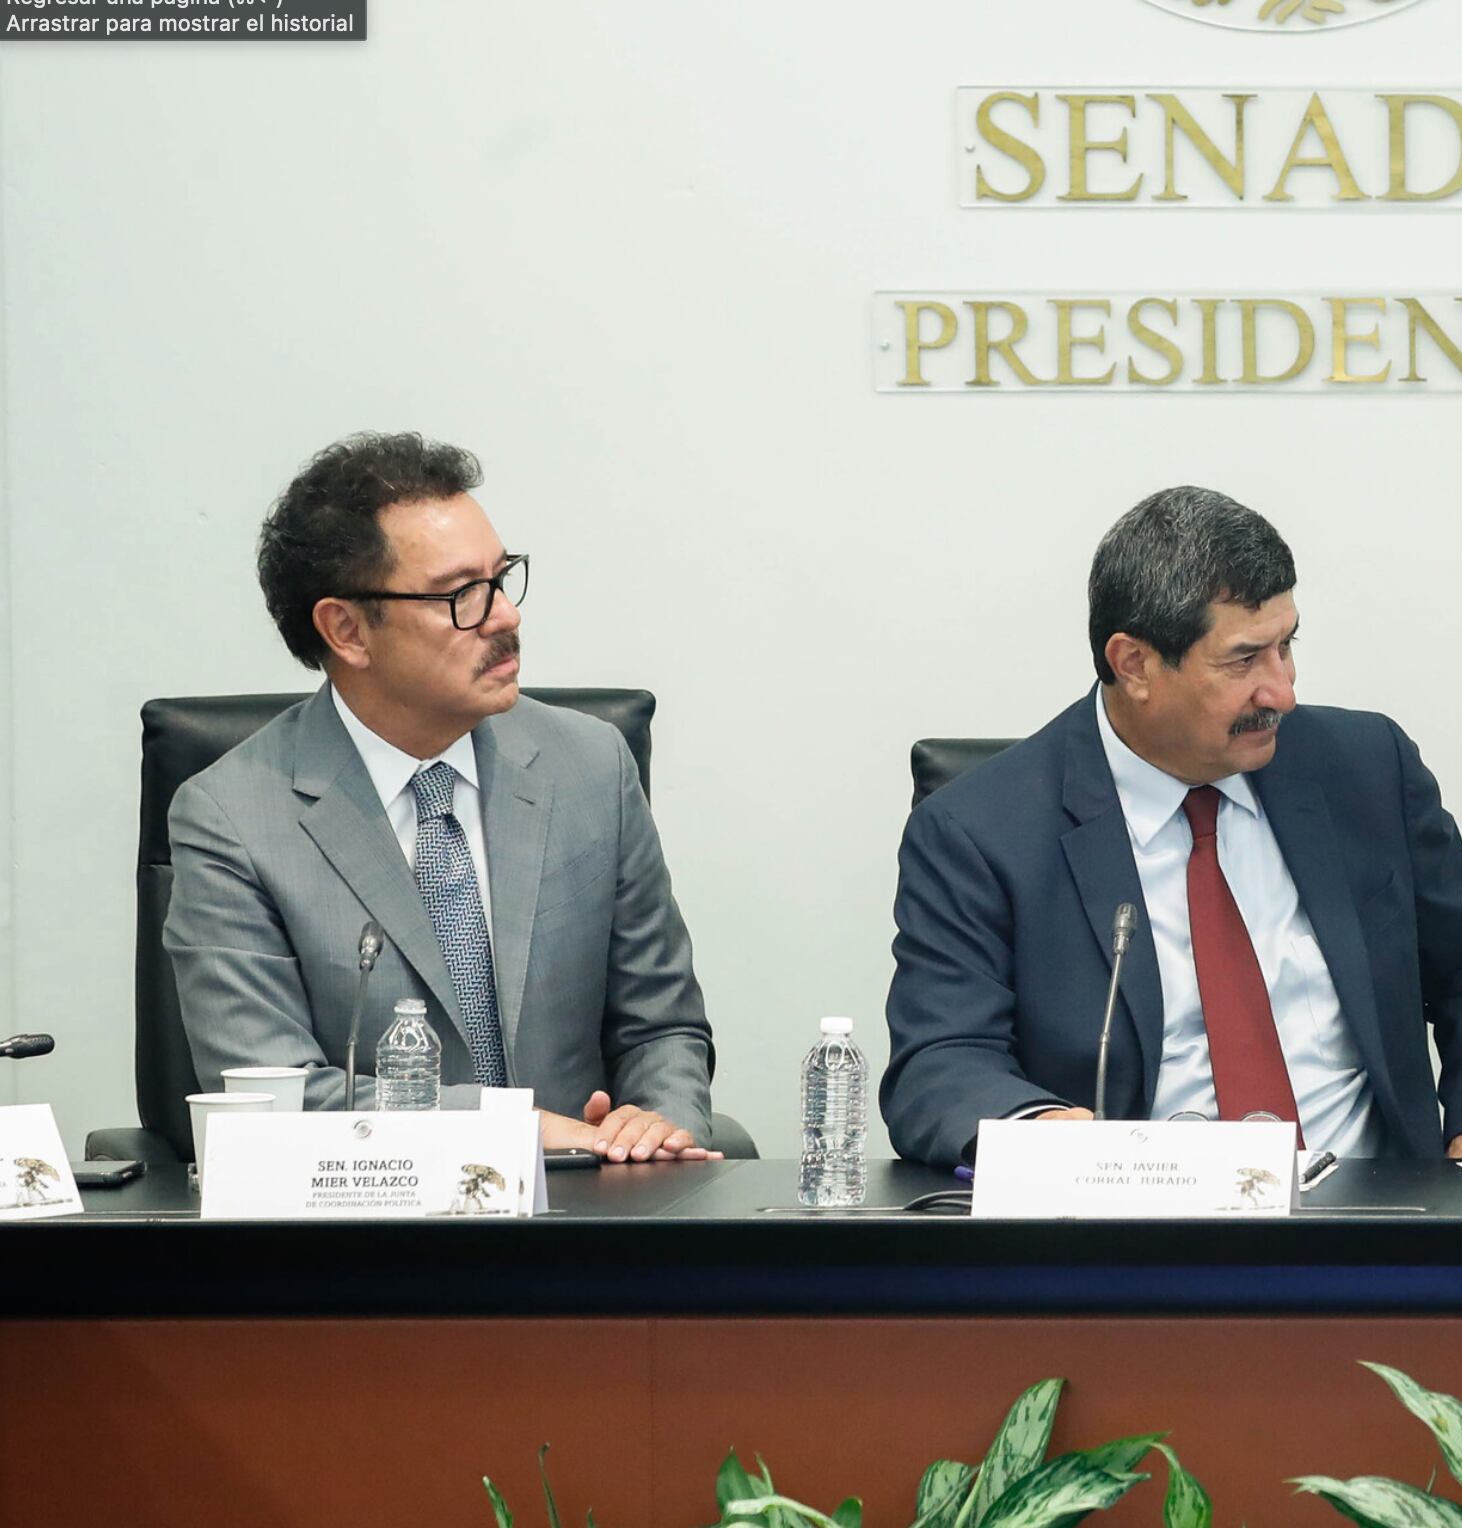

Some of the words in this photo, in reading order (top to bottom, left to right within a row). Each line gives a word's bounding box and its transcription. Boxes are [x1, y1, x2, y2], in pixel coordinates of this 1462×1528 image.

[353, 1159, 414, 1171] IGNACIO
[311, 1177, 348, 1188] MIER
[353, 1176, 419, 1187] VELAZCO
